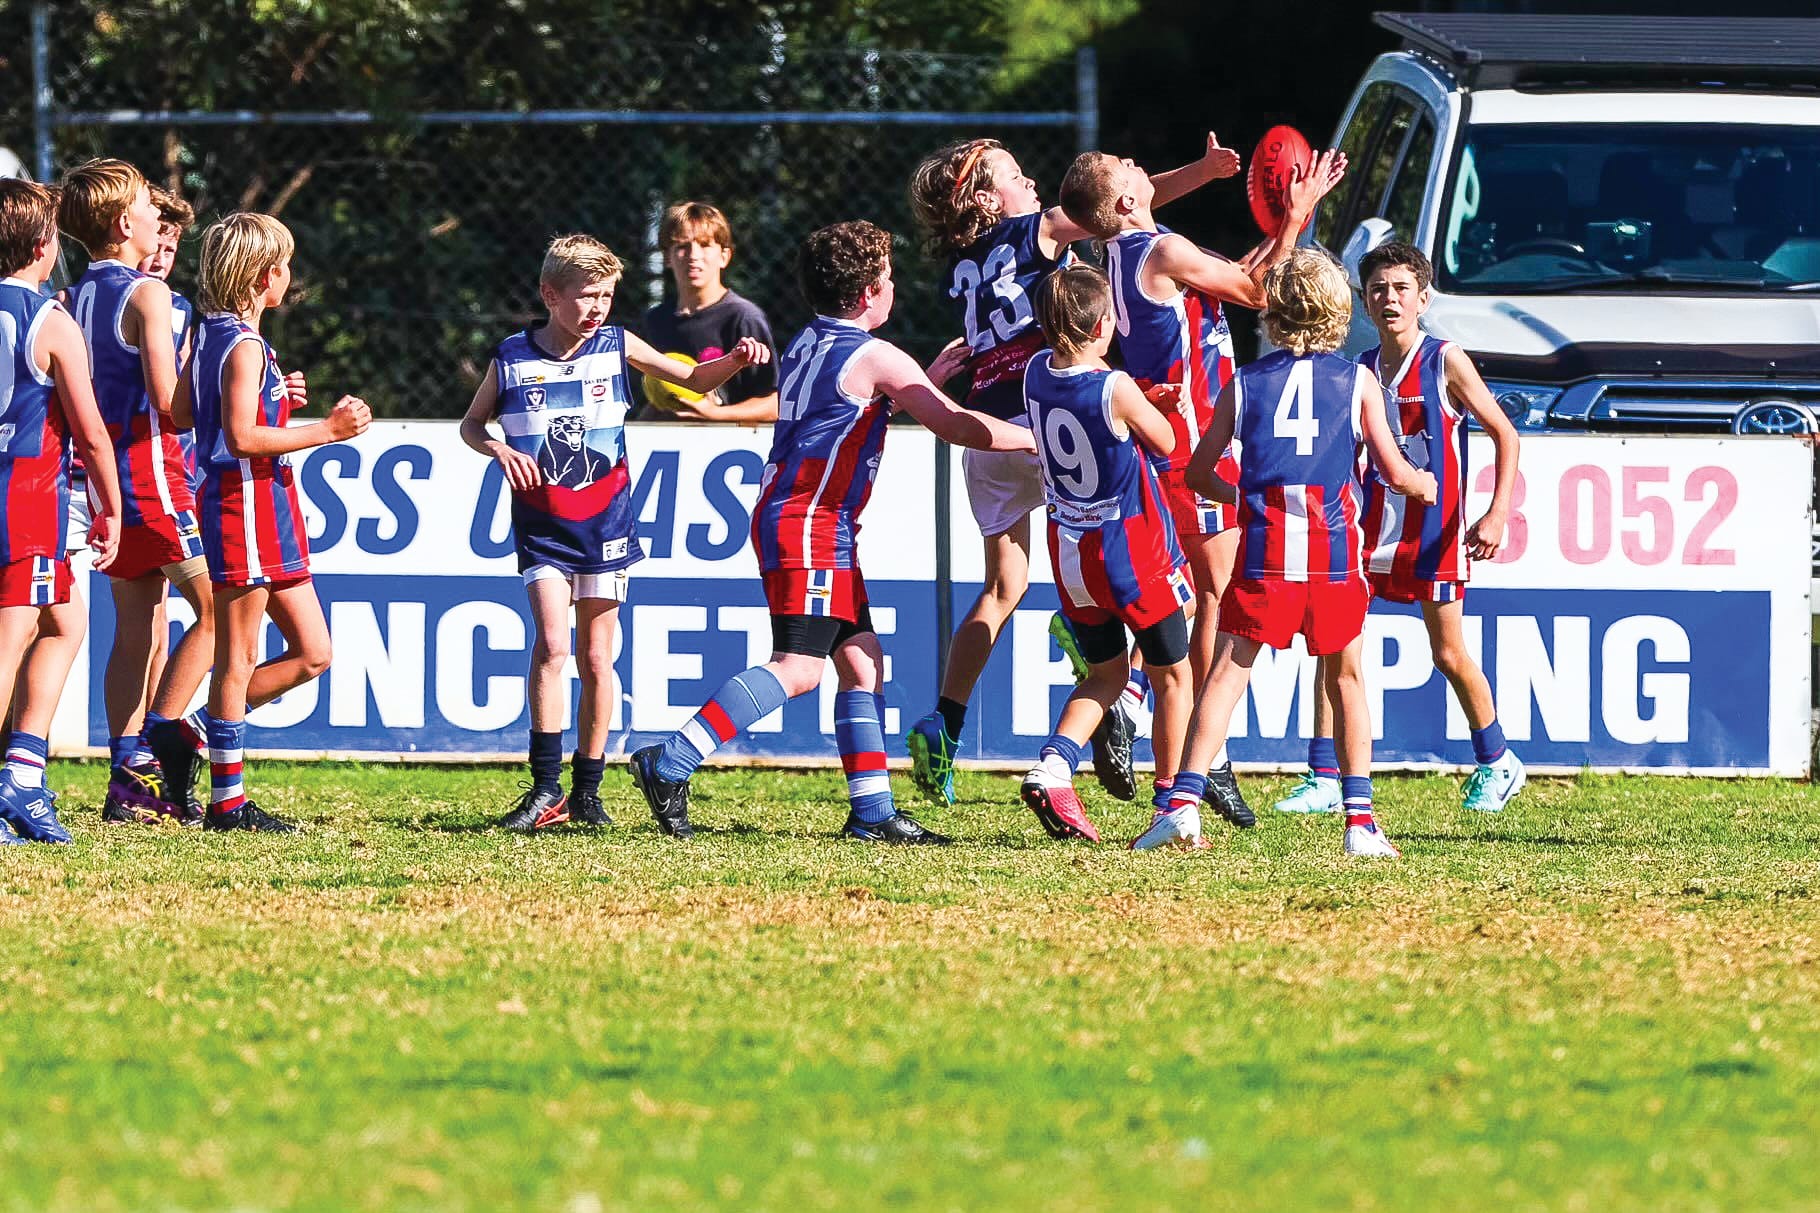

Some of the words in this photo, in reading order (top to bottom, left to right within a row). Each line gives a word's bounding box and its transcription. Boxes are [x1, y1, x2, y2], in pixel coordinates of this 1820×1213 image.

[948, 243, 1034, 353] 23
[1027, 398, 1099, 499] 19
[1272, 359, 1320, 456] 4
[1557, 463, 1740, 568] 052
[160, 596, 901, 734] ONCETE
[1011, 608, 1692, 745] PMPING
